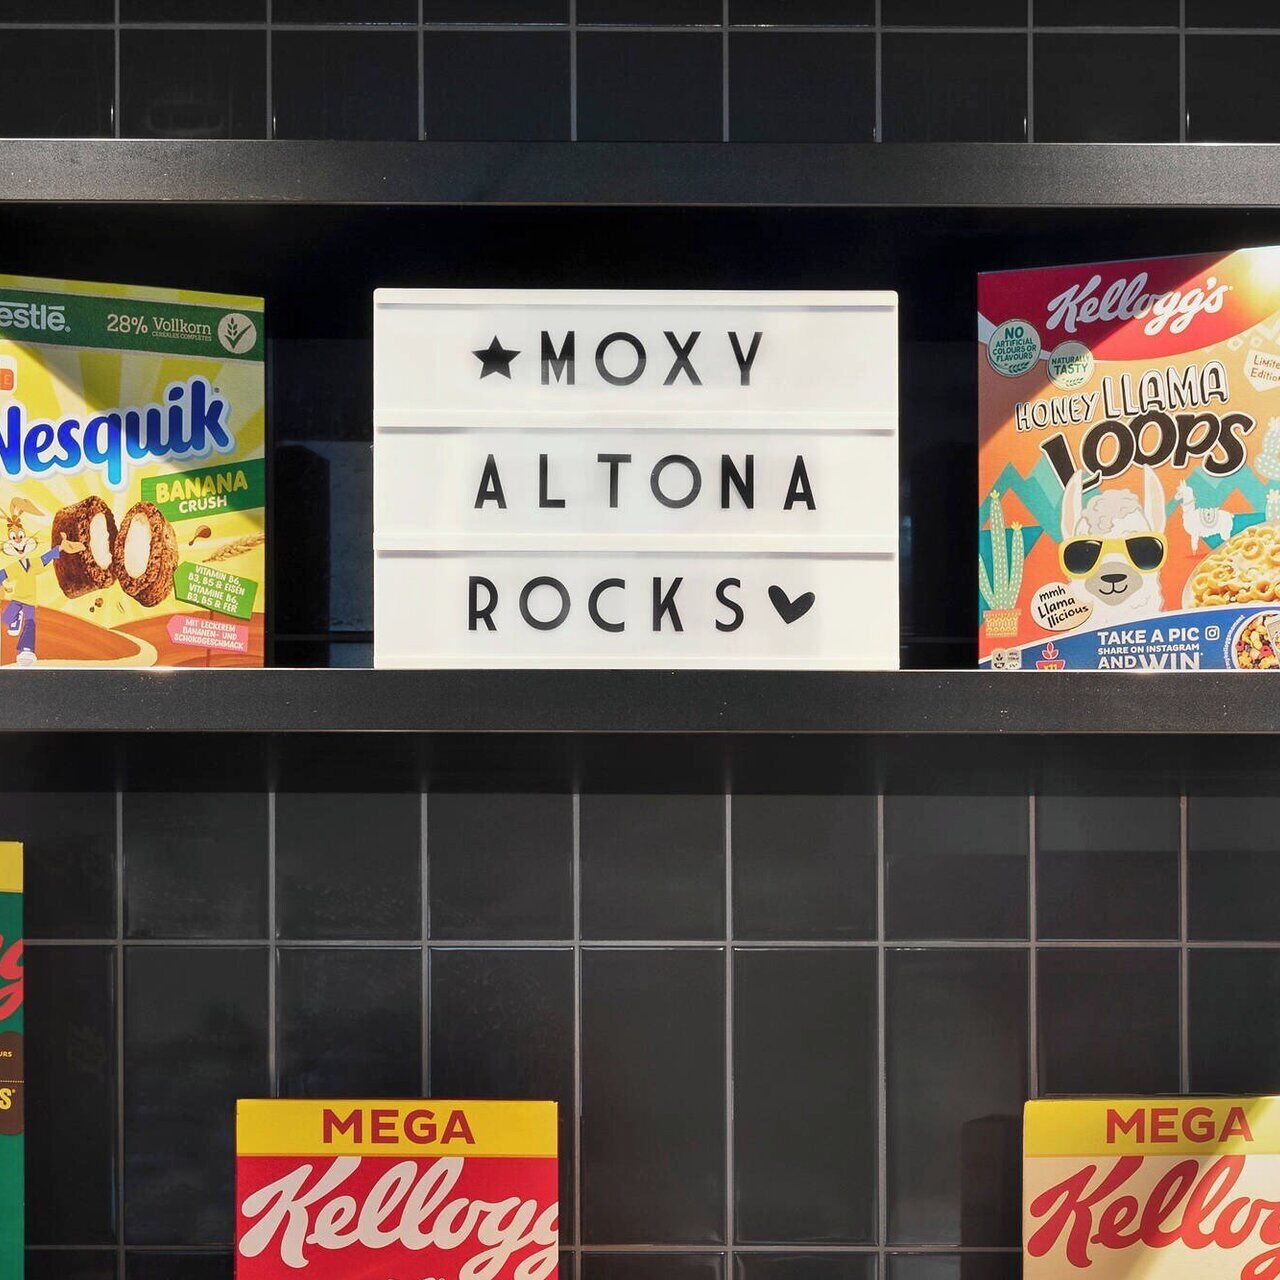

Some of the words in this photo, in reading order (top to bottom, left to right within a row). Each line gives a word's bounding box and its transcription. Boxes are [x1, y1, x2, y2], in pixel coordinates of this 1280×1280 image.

[1045, 271, 1230, 336] Kellogg's
[107, 313, 149, 335] 28%
[152, 316, 212, 335] Vollkorn
[1004, 326, 1024, 339] NO
[992, 345, 1026, 356] COLOURS
[995, 337, 1033, 348] ARTIFICIAL
[540, 330, 763, 386] MOXY
[996, 351, 1033, 362] FLAVOURS
[1053, 363, 1089, 375] TASTY
[1015, 391, 1100, 431] HONEY
[1101, 361, 1230, 420] LLAMA
[154, 470, 249, 503] BANANA
[473, 453, 817, 511] ALTONA
[178, 496, 228, 515] CRUSH
[195, 565, 227, 581] VITAMIN
[188, 583, 224, 599] VITAMINE
[1039, 585, 1066, 602] mmh
[467, 574, 745, 633] ROCKS
[1037, 597, 1076, 619] Llama
[185, 618, 198, 627] MIT
[200, 620, 236, 633] LECKEREM
[173, 633, 244, 650] SCHOKOGESCHMACK
[222, 631, 238, 641] UND
[1097, 629, 1147, 645] TAKE
[1151, 630, 1166, 643] A
[1169, 627, 1200, 642] PIC
[1097, 647, 1130, 655] SHARE
[1146, 643, 1200, 653] INSTAGRAM
[1097, 656, 1138, 669] AND
[321, 1108, 476, 1145] MEGA
[1105, 1106, 1254, 1144] MEGA
